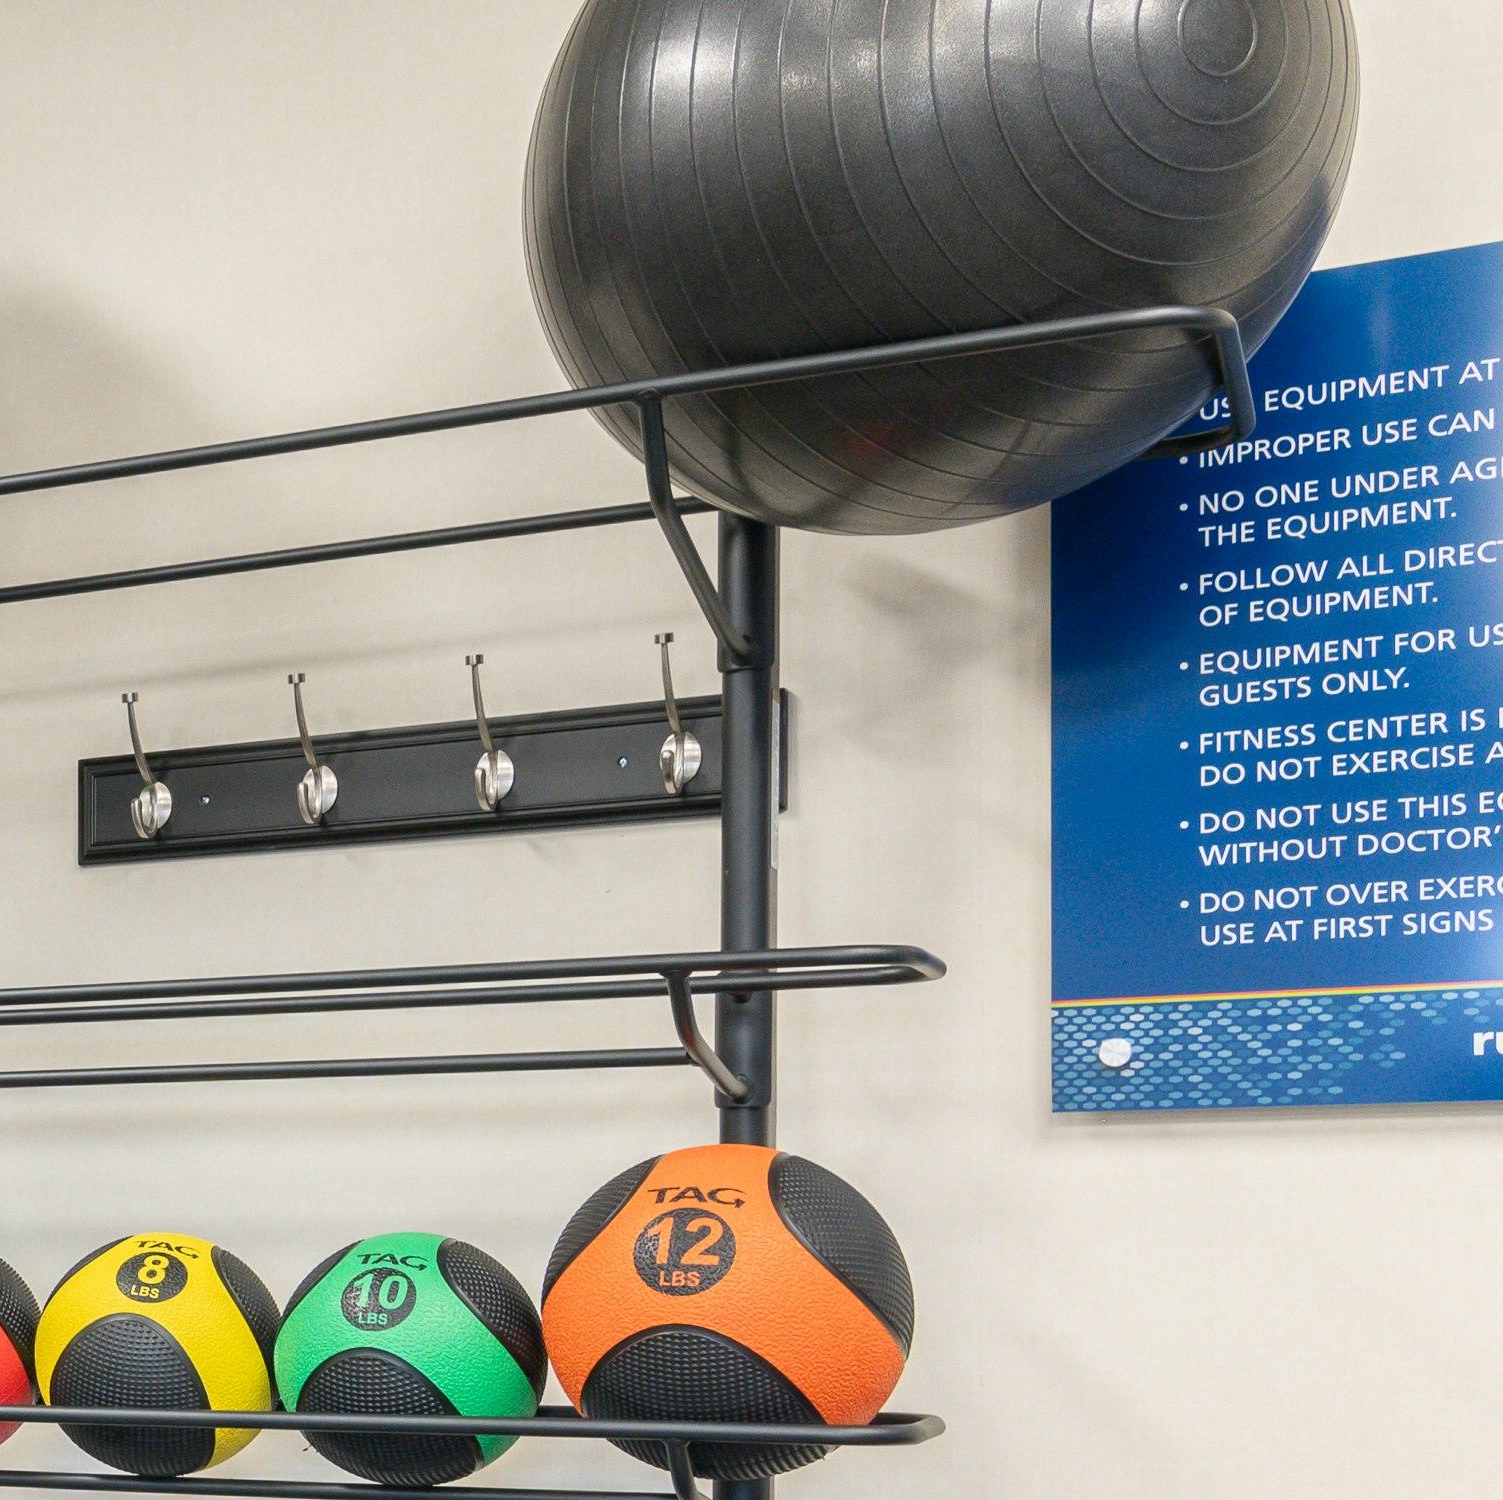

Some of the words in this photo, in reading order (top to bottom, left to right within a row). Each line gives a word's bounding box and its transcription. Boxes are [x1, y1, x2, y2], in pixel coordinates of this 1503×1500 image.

[1264, 364, 1450, 412] EQUIPMENT
[1458, 357, 1502, 385] AT
[1200, 428, 1351, 468] IMPROPER
[1362, 418, 1417, 446] USE
[1428, 407, 1495, 437] CAN
[1200, 490, 1244, 515] NO
[1255, 480, 1319, 508] ONE
[1331, 465, 1440, 498] UNDER
[1449, 456, 1503, 484] AG
[1198, 521, 1255, 547] THE
[1267, 496, 1457, 540] EQUIPMENT.
[1199, 560, 1328, 595] FOLLOW
[1336, 553, 1394, 579] ALL
[1199, 603, 1238, 627] OF
[1249, 581, 1438, 622] EQUIPMENT.
[1200, 635, 1384, 675] EQUIPMENT
[1394, 628, 1457, 655] FOR
[1199, 676, 1312, 707] GUESTS
[1322, 666, 1410, 695] ONLY.
[1199, 723, 1316, 754] FITNESS
[1327, 712, 1448, 743] CENTER
[1461, 708, 1486, 732] IS
[1200, 763, 1246, 787] DO
[1256, 756, 1322, 782] NOT
[1332, 743, 1474, 776] EXERCISE
[1200, 810, 1245, 834] DO
[1256, 804, 1322, 830] NOT
[1332, 799, 1388, 824] USE
[1397, 793, 1467, 819] THIS
[1198, 835, 1348, 867] WITHOUT
[1200, 890, 1245, 914] DO
[1254, 885, 1319, 911] NOT
[1325, 880, 1409, 906] OVER
[1200, 922, 1254, 946] USE
[1264, 919, 1304, 943] AT
[1313, 914, 1394, 940] FIRST
[1402, 908, 1495, 936] SIGNS
[646, 1186, 747, 1208] TAG
[357, 1252, 430, 1271] TAG
[646, 1216, 724, 1266] 12
[137, 1254, 170, 1285] 8
[659, 1270, 701, 1287] LBS
[130, 1284, 160, 1299] LBS
[353, 1273, 408, 1310] 10
[357, 1311, 388, 1325] LBS
